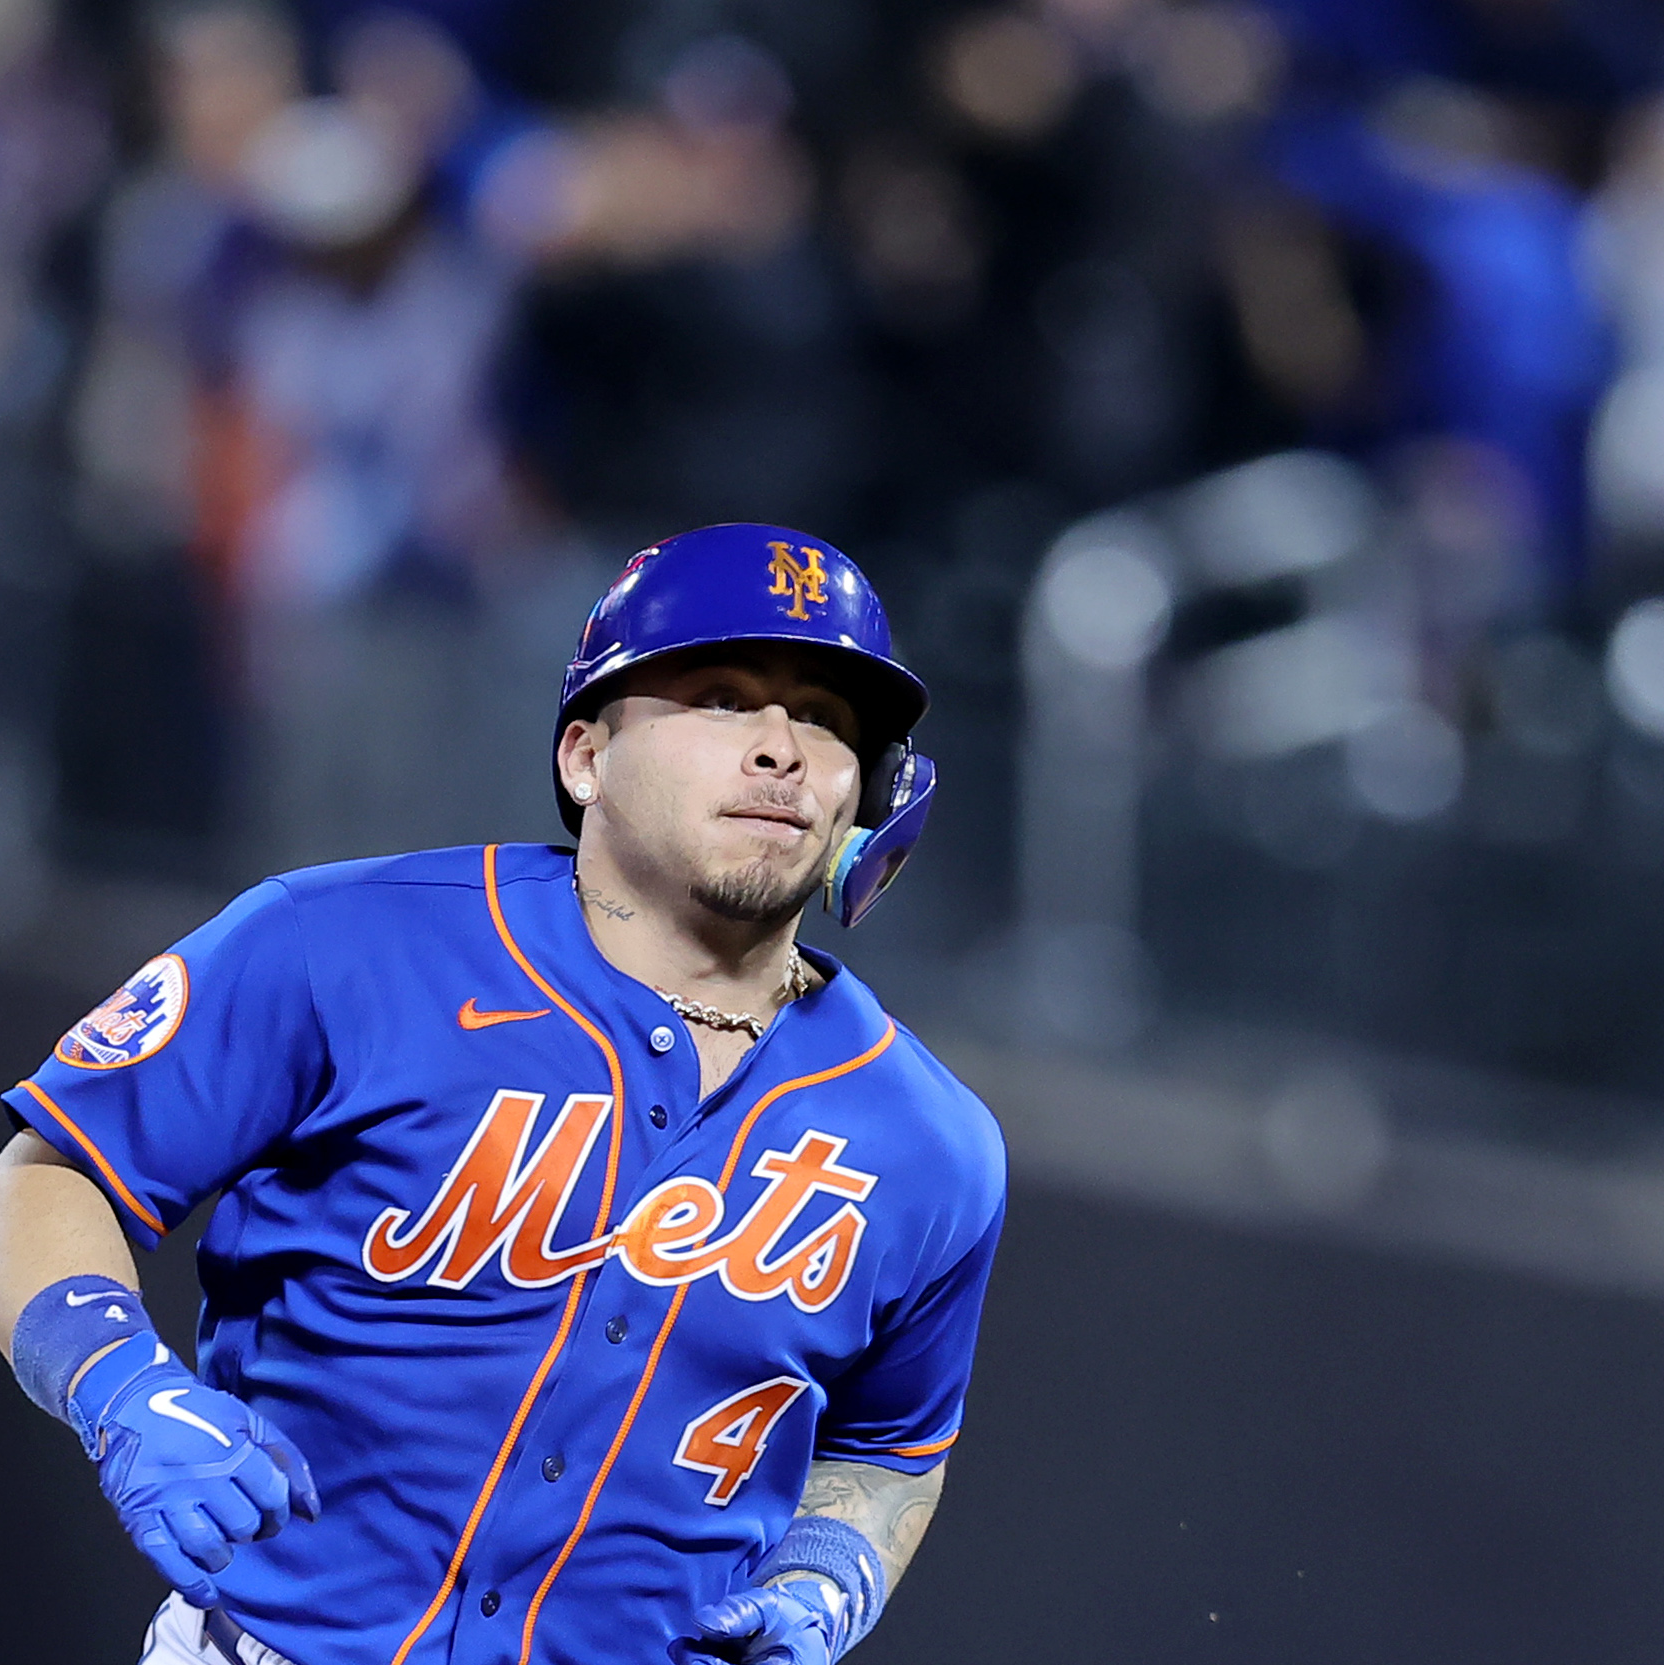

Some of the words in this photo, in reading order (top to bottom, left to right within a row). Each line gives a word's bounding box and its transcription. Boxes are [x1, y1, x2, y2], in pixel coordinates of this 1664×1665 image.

[766, 541, 829, 621] NY
[361, 1088, 880, 1314] Mets
[104, 1304, 129, 1323] 4
[671, 1375, 811, 1507] 4
